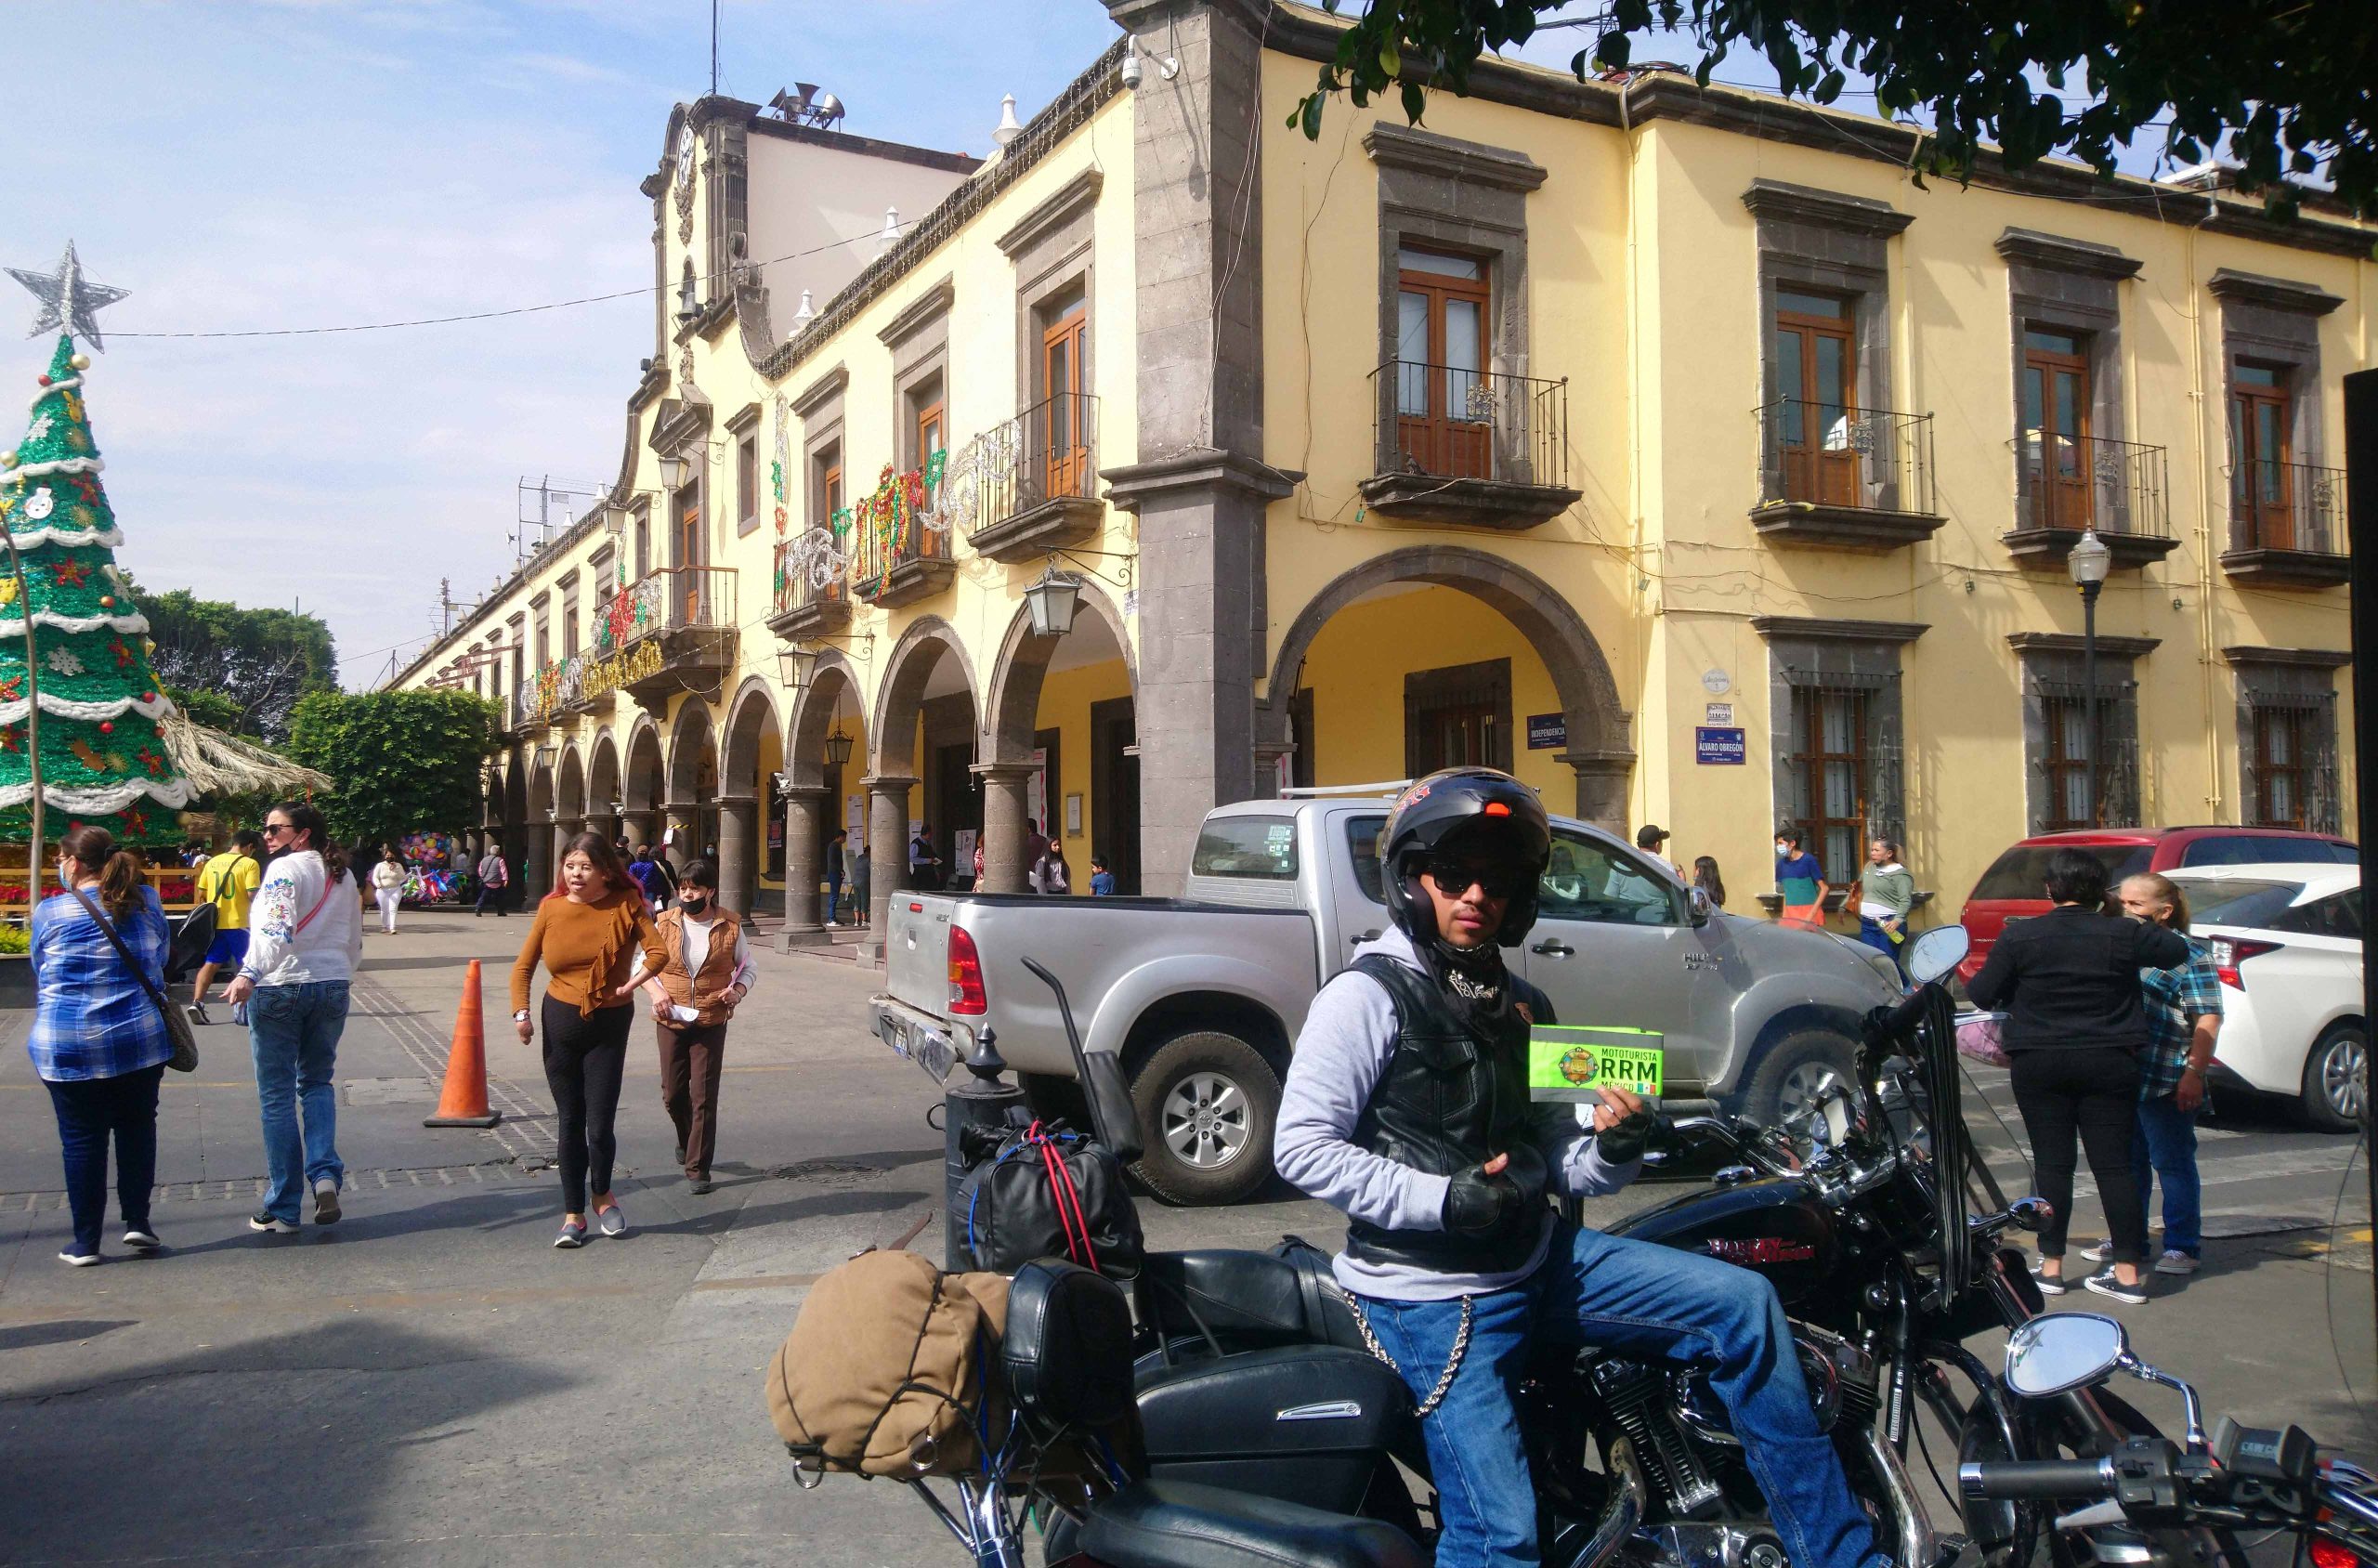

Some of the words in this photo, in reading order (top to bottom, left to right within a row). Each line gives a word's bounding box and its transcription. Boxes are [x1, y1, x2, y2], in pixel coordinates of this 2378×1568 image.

[1531, 727, 1566, 738] INDEPENDENCIA
[1699, 741, 1718, 751] ÁLVARO
[1719, 742, 1744, 752] OBREGÓN
[213, 871, 236, 899] 10
[1601, 1048, 1657, 1061] MOTOTURISTA
[1601, 1058, 1656, 1083] RRM
